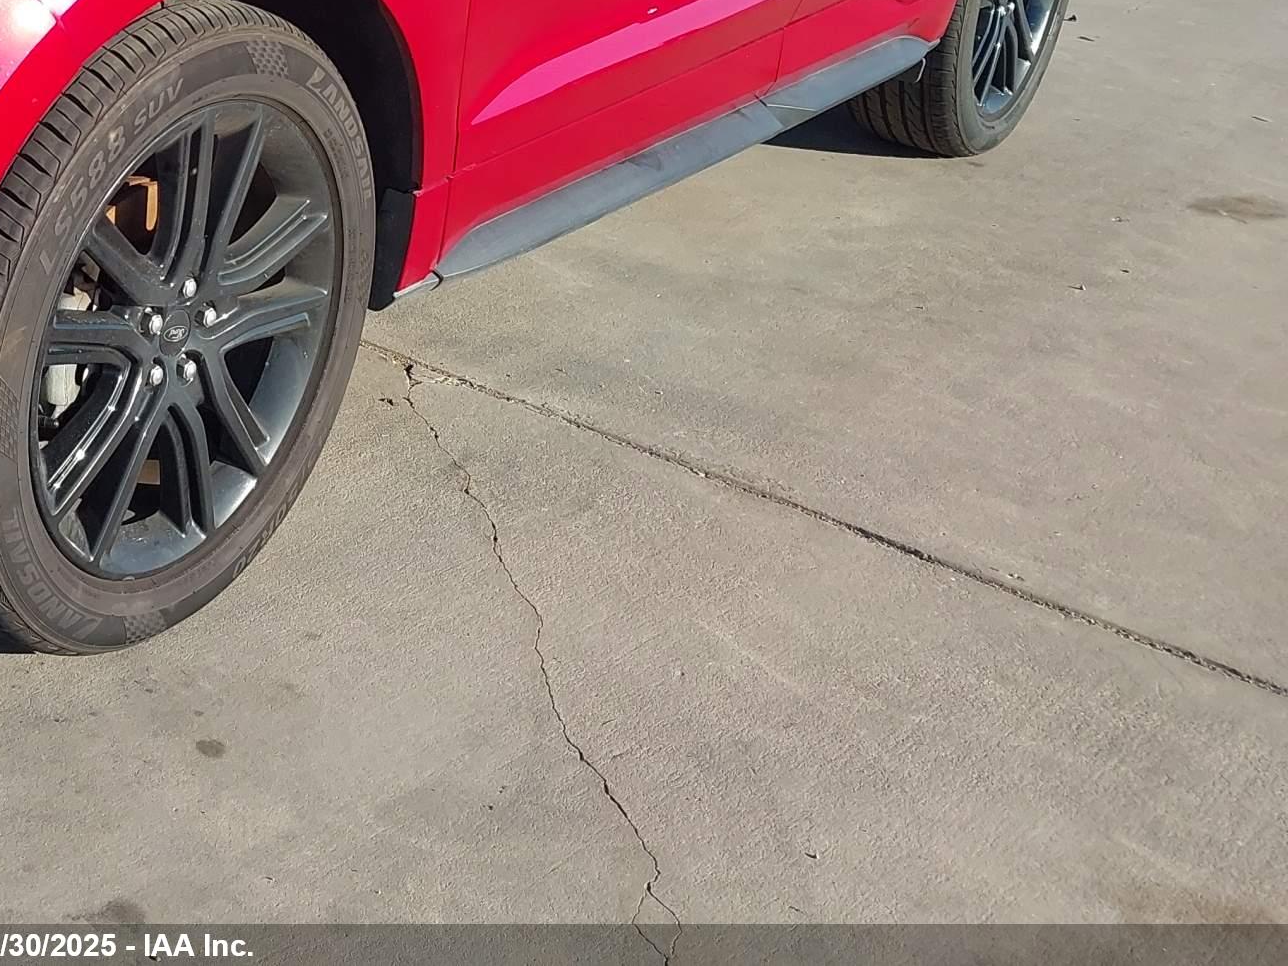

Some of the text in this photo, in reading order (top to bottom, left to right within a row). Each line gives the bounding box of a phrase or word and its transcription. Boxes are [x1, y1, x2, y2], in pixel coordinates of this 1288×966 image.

[38, 77, 185, 275] LS588 SUV
[305, 65, 374, 212] LANDSAIL
[0, 505, 104, 640] LANDSAIL
